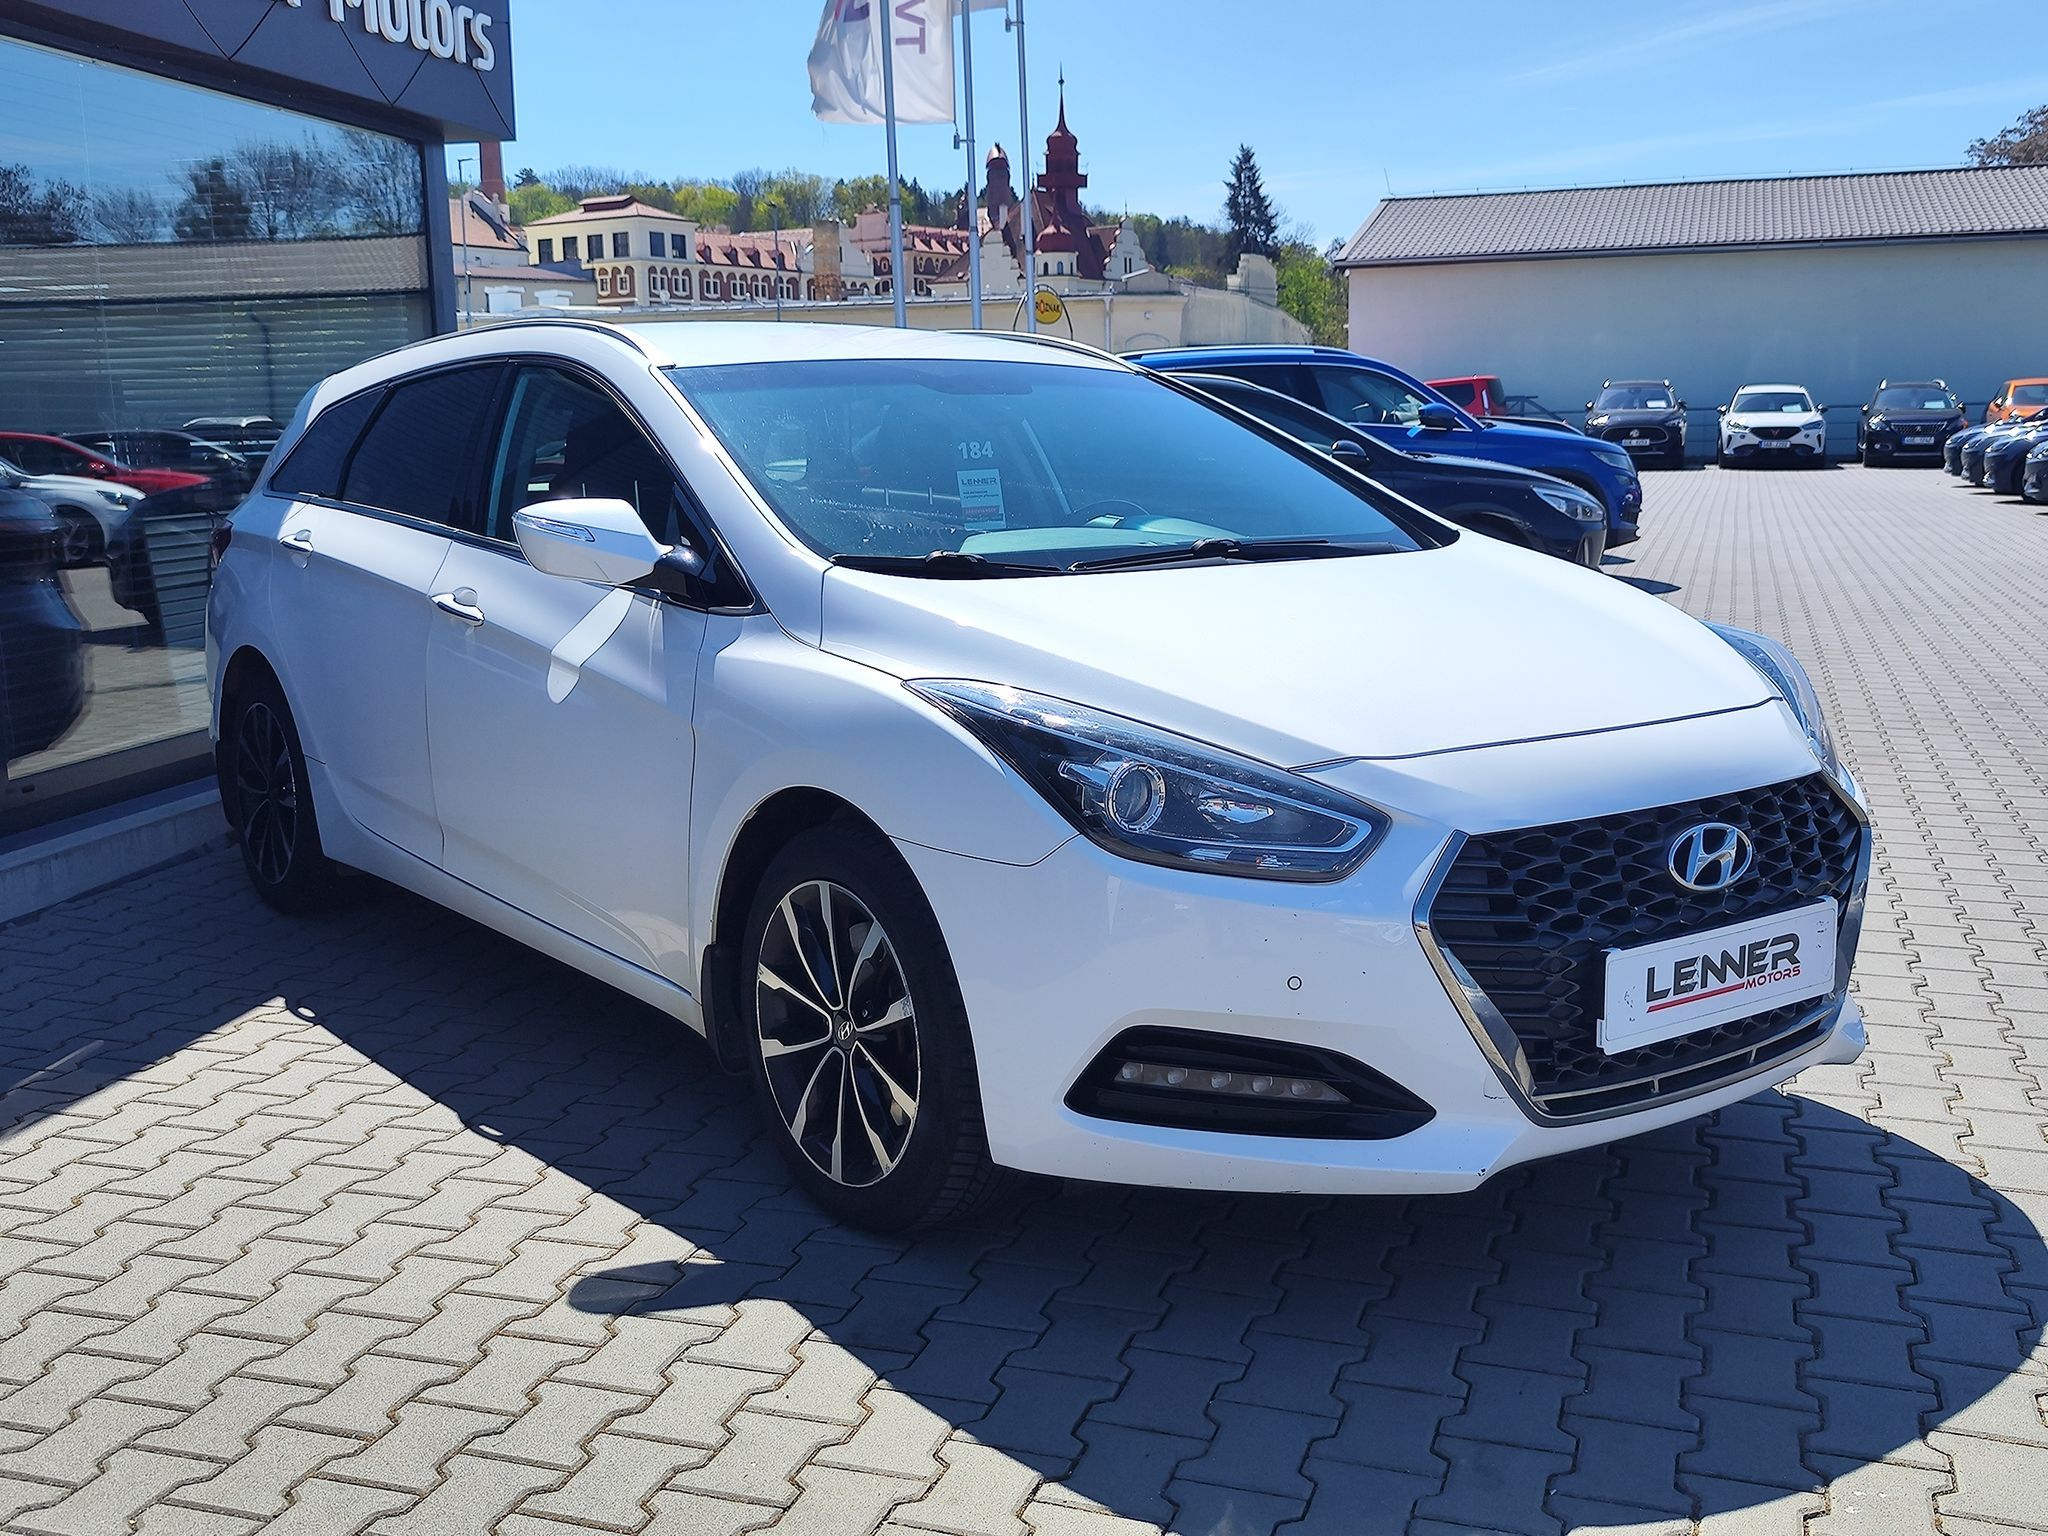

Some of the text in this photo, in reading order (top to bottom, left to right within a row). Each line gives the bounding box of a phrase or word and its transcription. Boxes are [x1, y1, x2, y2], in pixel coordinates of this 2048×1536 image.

[958, 441, 994, 459] 184
[1646, 932, 1801, 1003] LENNER
[1744, 965, 1801, 991] MOTORS
